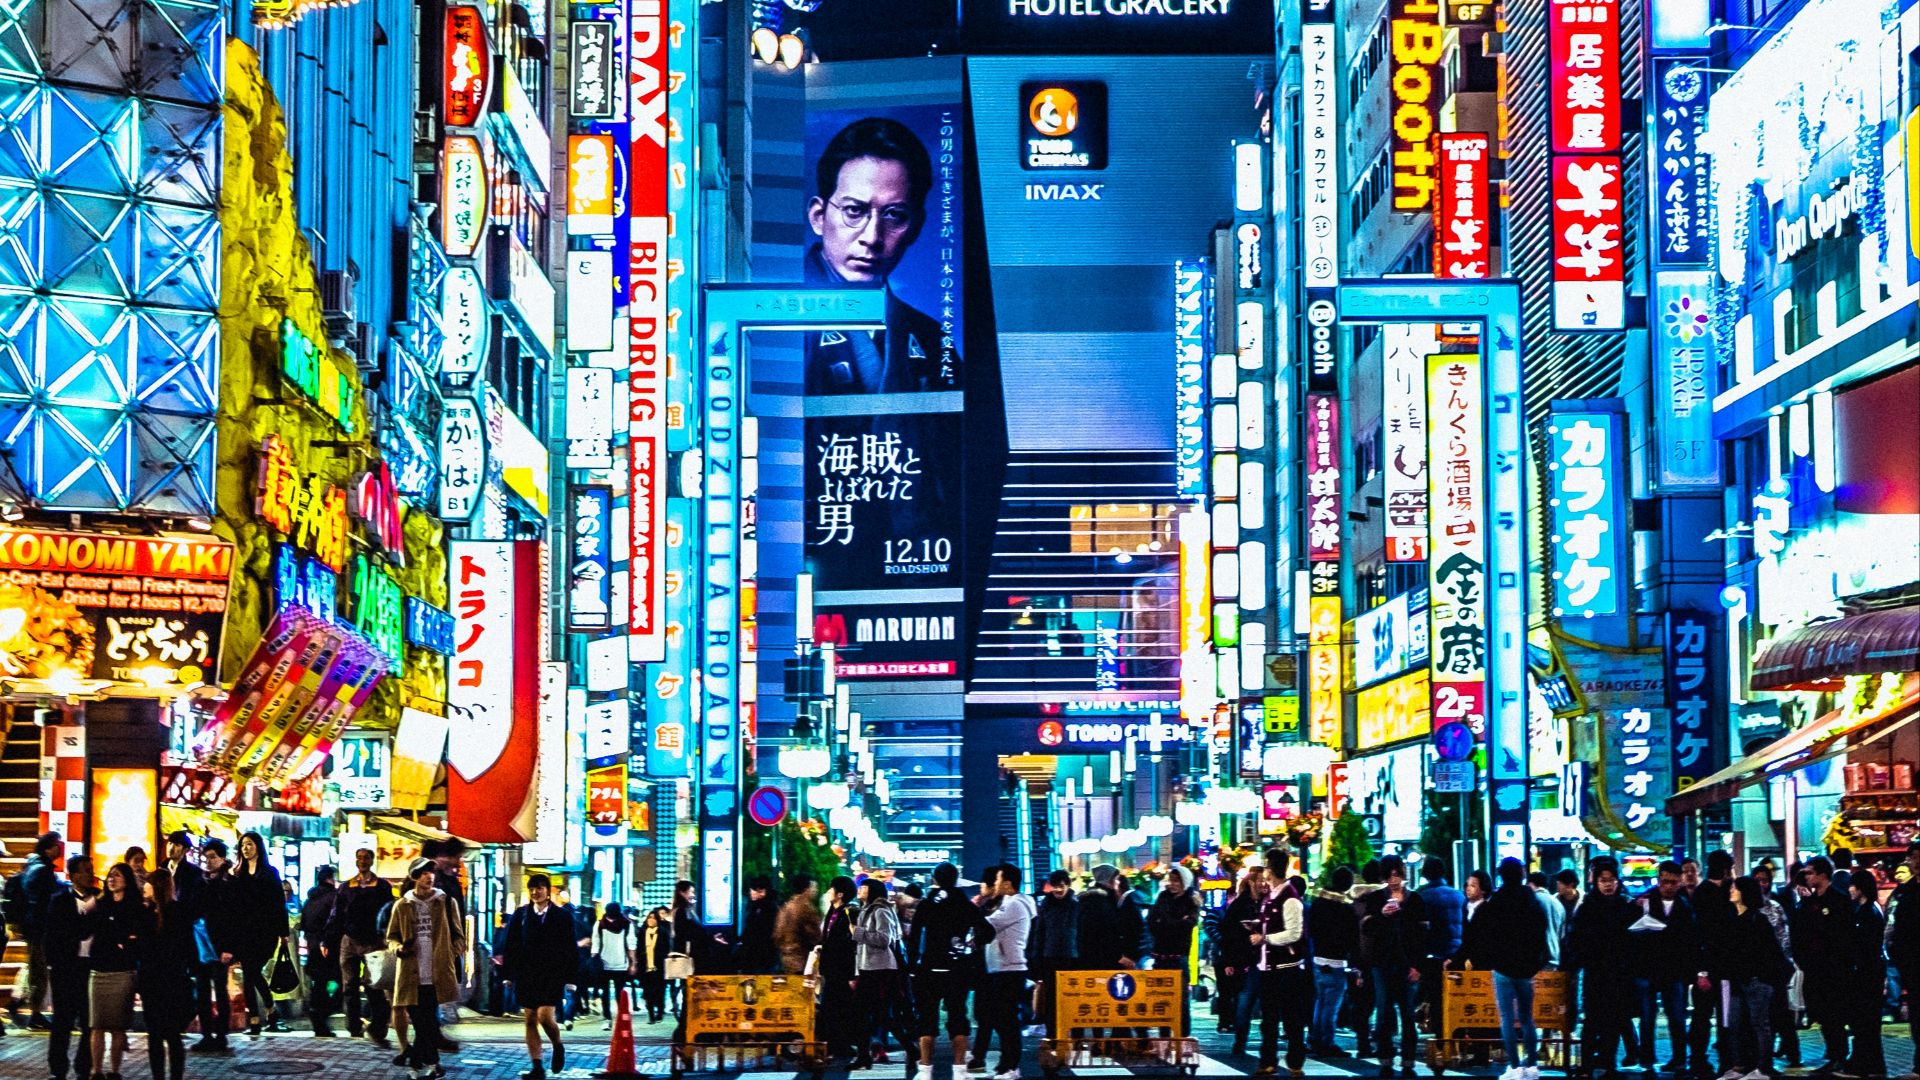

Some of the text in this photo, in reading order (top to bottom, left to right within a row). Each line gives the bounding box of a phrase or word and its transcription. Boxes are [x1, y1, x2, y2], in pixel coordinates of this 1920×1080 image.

[1009, 0, 1231, 16] HOTEL GRACERY
[1458, 5, 1484, 21] 6F
[1029, 153, 1089, 167] CINEMAS
[1025, 184, 1102, 200] IMAX
[1776, 215, 1807, 265] Don
[1351, 294, 1489, 306] CENTRAL ROAD
[630, 242, 657, 422] BIC DRUG
[448, 373, 470, 385] 1F
[817, 432, 922, 476] 海賊と
[1674, 440, 1705, 461] 5F
[817, 476, 913, 502] よばれた
[448, 497, 469, 511] B1
[1561, 420, 1611, 607] カラオケ
[816, 504, 855, 546] 男
[147, 542, 232, 577] YAKI
[709, 366, 731, 740] GODZILLA ROAD
[883, 538, 952, 564] 12.10
[1395, 537, 1428, 558] B1
[884, 564, 950, 575] ROADSHOW
[1312, 561, 1339, 577] 4F
[66, 574, 110, 590] dinner
[112, 577, 142, 592] with
[143, 578, 227, 599] Free-Flowing
[1312, 577, 1339, 593] 3F
[64, 590, 107, 606] Drinks
[108, 593, 129, 607] for
[129, 594, 141, 607] 2
[142, 594, 180, 609] hours
[457, 555, 486, 688] トラノコ
[1435, 552, 1485, 675] 金の蔵
[856, 616, 955, 642] MARUHAN
[1436, 686, 1475, 718] 2F
[1675, 620, 1710, 768] カラオケ
[1066, 723, 1122, 742] TOHO
[1620, 707, 1656, 829] カラオケ
